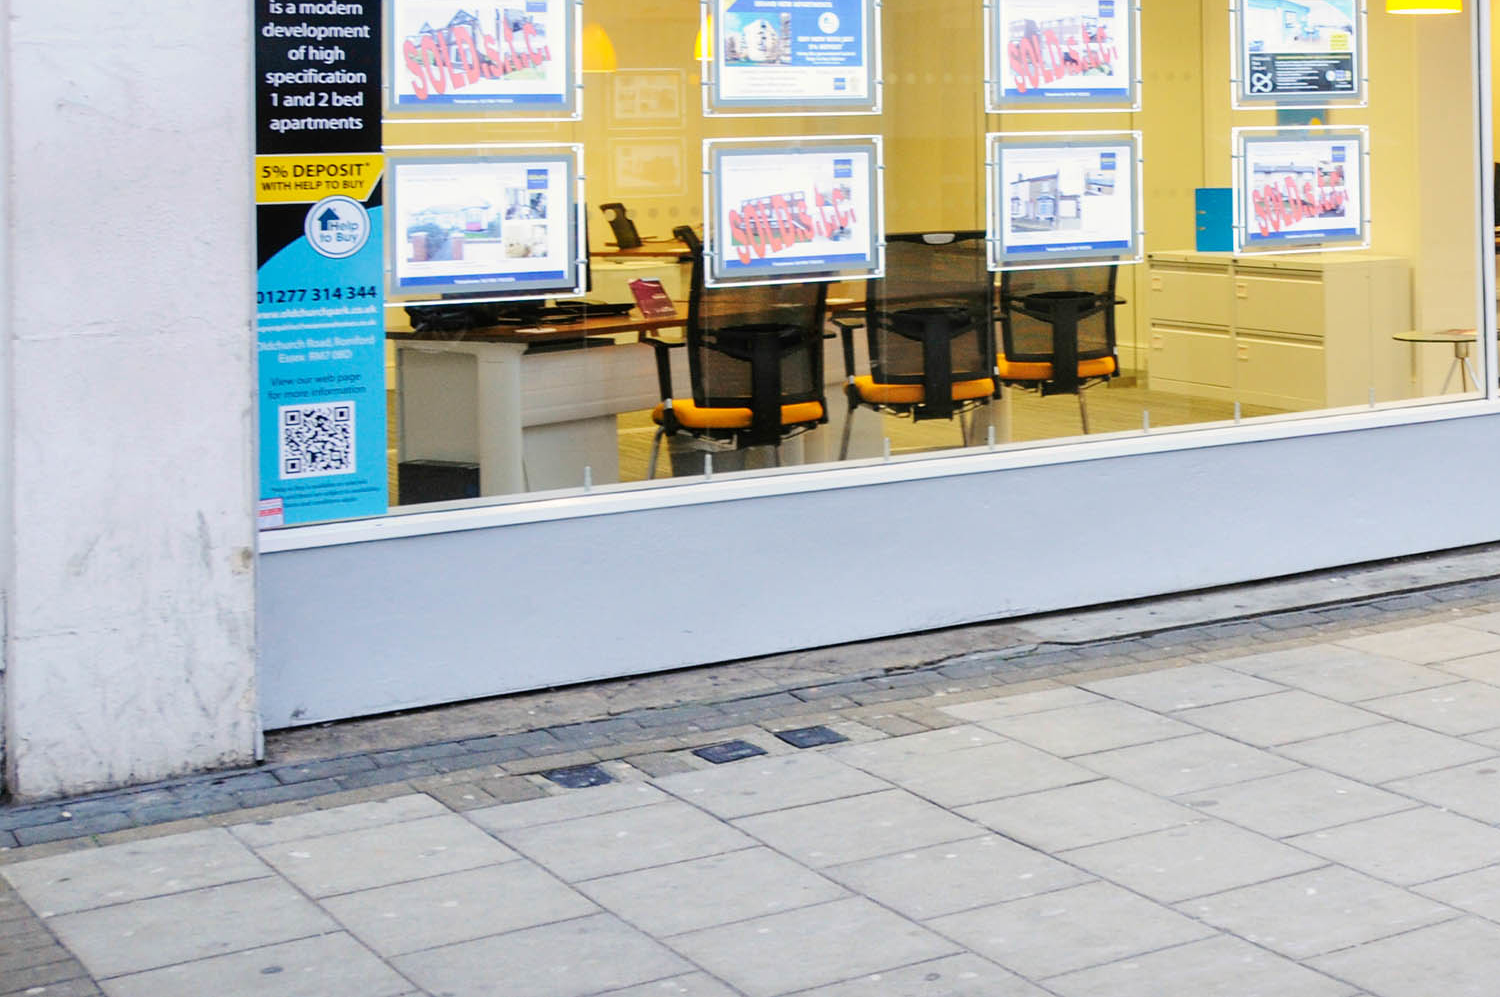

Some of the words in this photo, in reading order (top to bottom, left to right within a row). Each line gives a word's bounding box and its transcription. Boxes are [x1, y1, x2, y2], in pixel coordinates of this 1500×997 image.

[269, 0, 283, 14] is
[285, 3, 296, 14] a
[299, 0, 363, 15] modern
[262, 22, 371, 41] development
[287, 45, 307, 60] of
[308, 45, 345, 64] high
[403, 26, 480, 101] SOLD
[265, 68, 367, 87] specification
[270, 93, 278, 106] 1
[283, 92, 315, 107] and
[318, 93, 329, 106] 2
[332, 92, 363, 107] bed
[269, 117, 363, 133] apartments
[261, 165, 288, 178] 5%
[262, 181, 292, 191] WITH
[294, 181, 323, 191] HELP
[325, 180, 340, 190] TO
[342, 180, 365, 190] BUY
[329, 221, 359, 232] Help
[729, 194, 796, 265] SOLD
[319, 233, 332, 243] to
[336, 232, 358, 244] Buy
[257, 289, 307, 304] 01277
[312, 287, 342, 301] 314
[347, 286, 377, 300] 344
[271, 377, 293, 386] View
[297, 377, 313, 385] our
[315, 374, 335, 383] web
[337, 374, 361, 384] page
[267, 390, 281, 400] for
[284, 390, 309, 398] more
[312, 386, 366, 396] information
